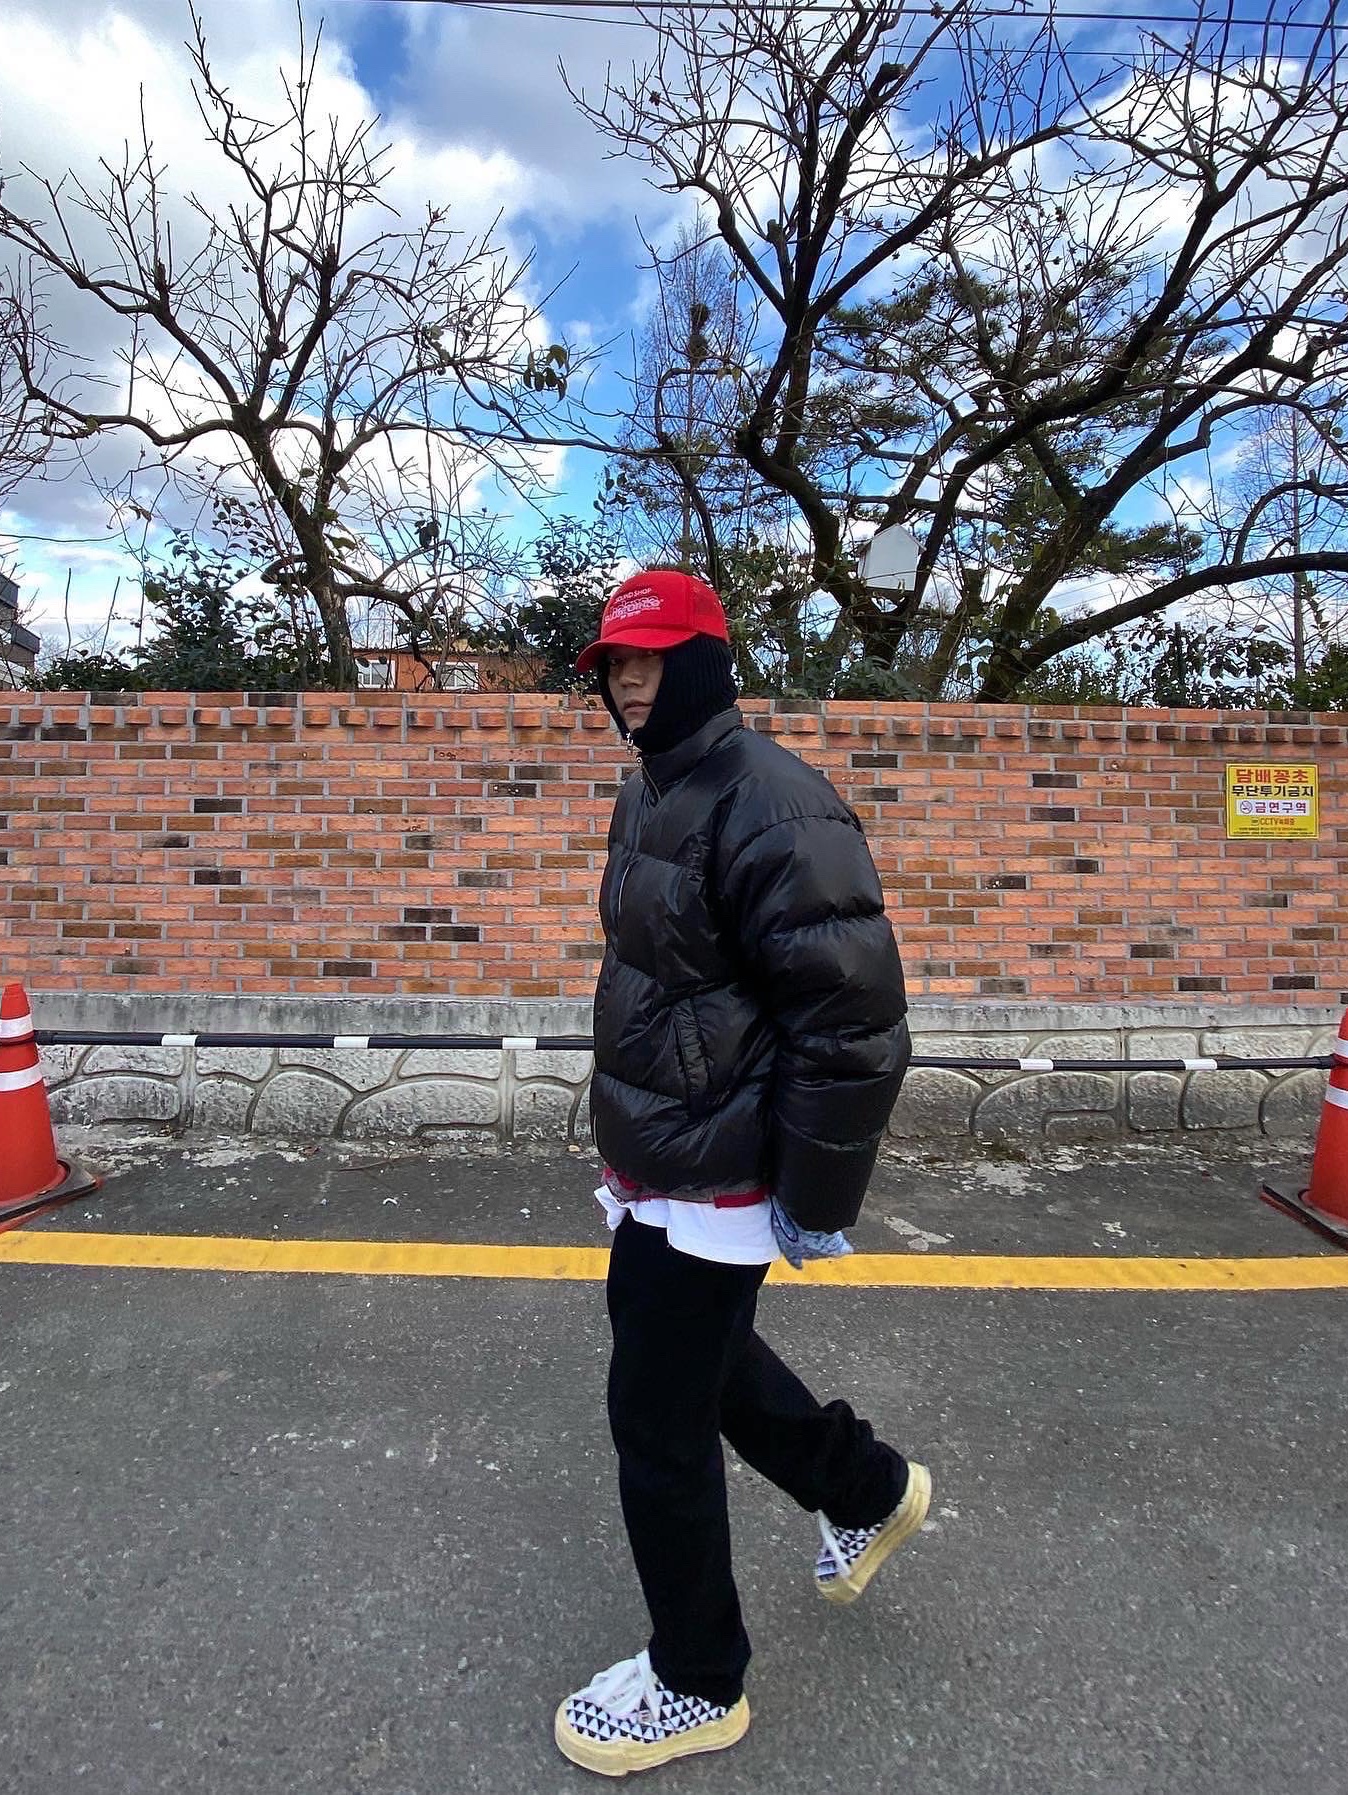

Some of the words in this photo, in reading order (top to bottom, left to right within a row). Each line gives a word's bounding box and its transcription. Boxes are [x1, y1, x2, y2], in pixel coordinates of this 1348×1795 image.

[634, 588, 652, 597] SHOP
[1235, 768, 1309, 784] 담배꽁초
[1231, 785, 1314, 797] 무단투기금지
[1255, 801, 1306, 813] 금연구역
